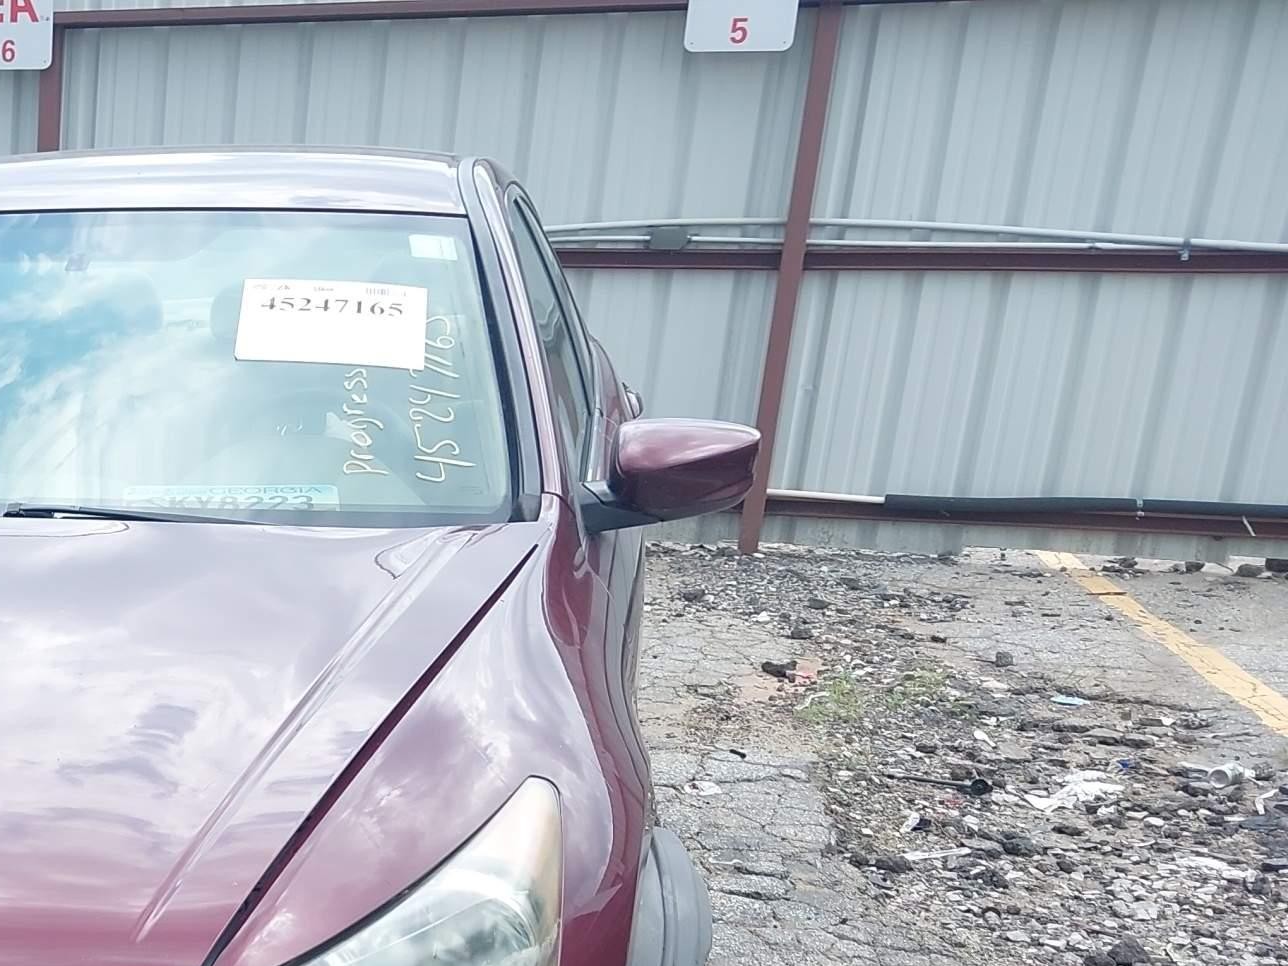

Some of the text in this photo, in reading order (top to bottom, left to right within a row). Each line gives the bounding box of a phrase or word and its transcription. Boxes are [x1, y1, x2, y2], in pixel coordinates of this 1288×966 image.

[729, 17, 749, 44] 5
[1, 39, 16, 63] 6
[260, 296, 404, 318] 45247165
[208, 486, 322, 494] GEORGIA
